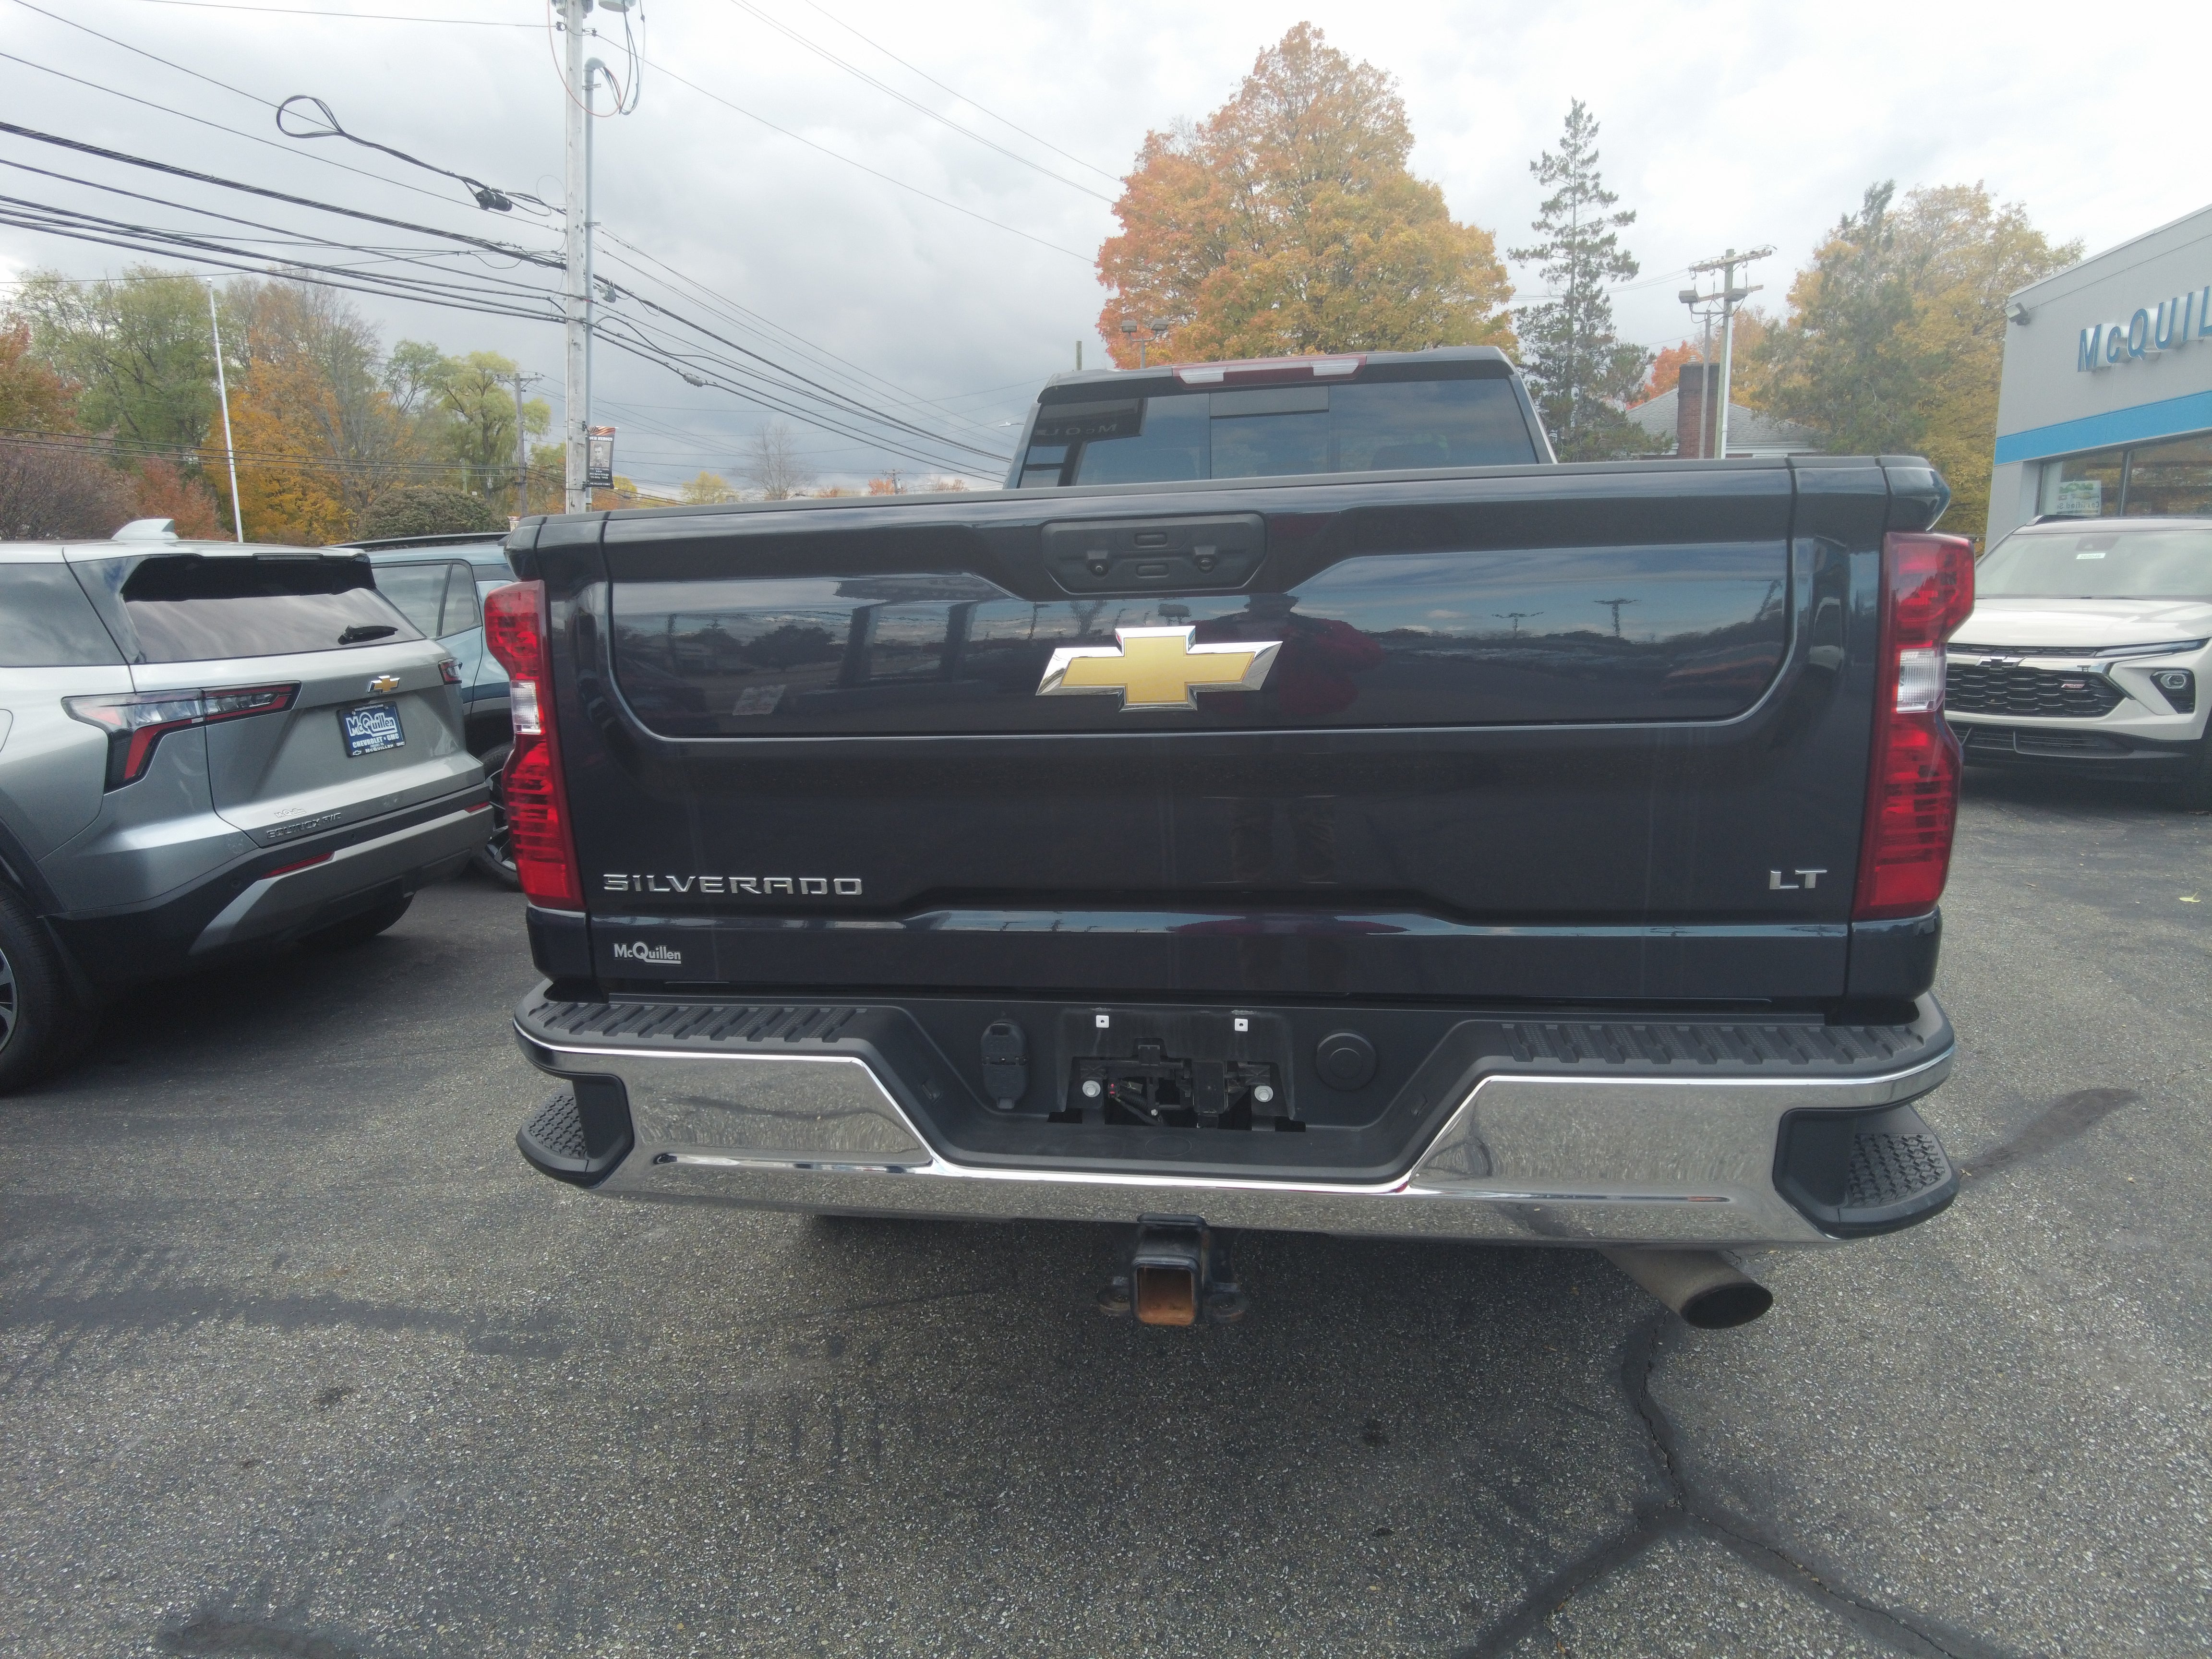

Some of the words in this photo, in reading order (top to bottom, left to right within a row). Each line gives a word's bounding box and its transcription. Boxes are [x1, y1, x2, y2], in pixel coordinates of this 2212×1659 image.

[346, 712, 397, 737] McQuillen
[352, 737, 383, 748] CHEVROLET
[266, 818, 321, 838] EQUINOX
[603, 874, 863, 895] SILVERADO
[1769, 869, 1828, 890] LT
[613, 942, 682, 964] McQuillen
